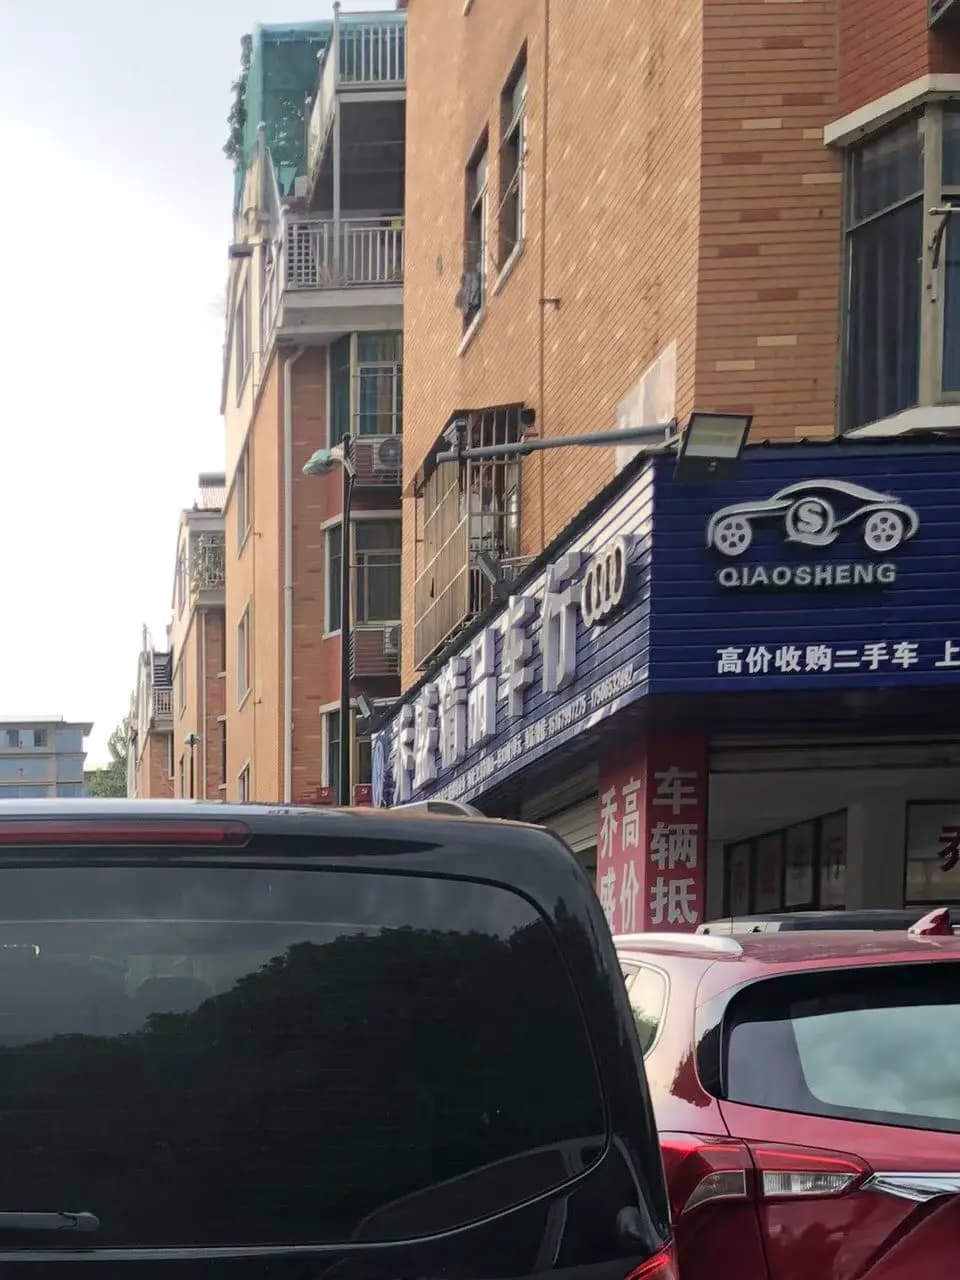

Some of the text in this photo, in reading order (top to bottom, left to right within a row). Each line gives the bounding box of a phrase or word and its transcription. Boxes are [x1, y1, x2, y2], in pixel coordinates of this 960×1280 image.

[718, 563, 896, 588] QIAOSHENG
[716, 642, 919, 674] 高价收购二手车
[620, 776, 641, 934] 高价
[650, 765, 699, 925] 车辆抵
